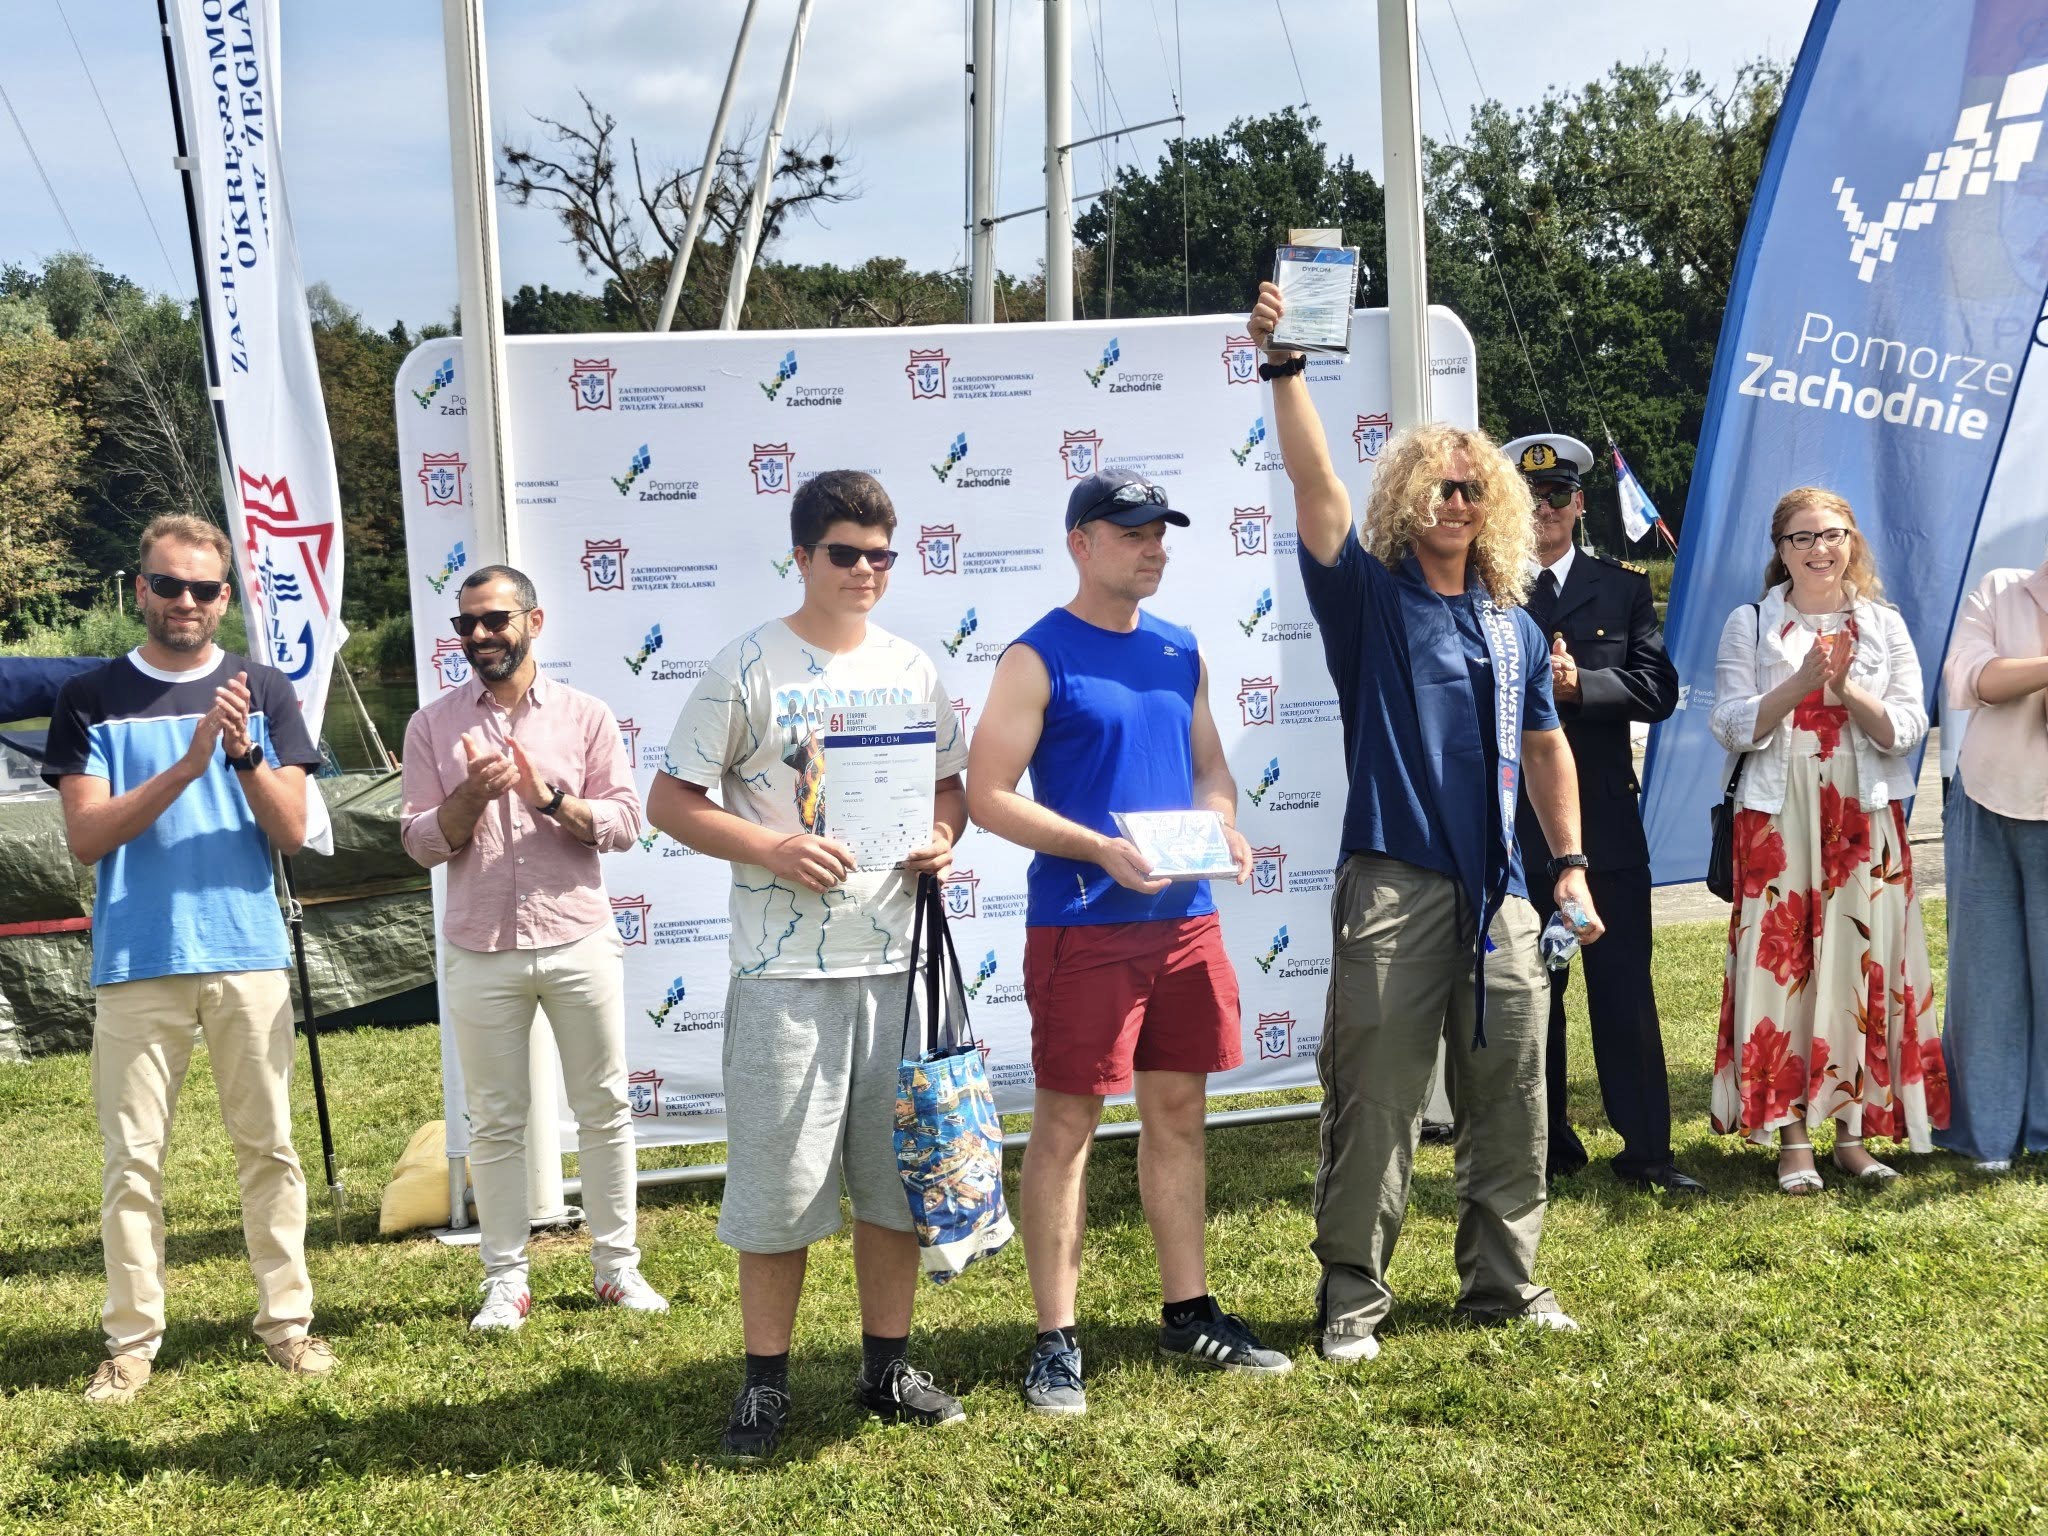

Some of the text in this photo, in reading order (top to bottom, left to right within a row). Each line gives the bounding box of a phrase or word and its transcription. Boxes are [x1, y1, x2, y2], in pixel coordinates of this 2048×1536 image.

[1797, 312, 2014, 396] Pomorze
[1431, 356, 1468, 367] omorze
[1118, 372, 1164, 383] Pomorze
[1304, 374, 1342, 383] EGLARSKI
[796, 386, 844, 397] Pomorze
[1109, 382, 1162, 393] Zachodnie
[786, 396, 842, 407] Zachodnie
[1738, 352, 1989, 440] Zachodnie
[1255, 461, 1284, 471] Zacho
[966, 467, 1012, 478] Pomorze
[650, 480, 699, 491] Pomorze
[957, 477, 1010, 488] Zachodnie
[516, 497, 557, 505] EGLARSKI
[639, 490, 697, 501] Zachodnie
[1271, 621, 1314, 632] Pomorze
[1261, 630, 1312, 642] Zachodnie
[976, 642, 1008, 652] Pomo
[966, 653, 1001, 663] Zacho
[861, 735, 900, 745] DYPLOM
[1278, 791, 1322, 801] Pomorze
[1269, 800, 1319, 811] Zachodnie
[692, 933, 729, 942] ŻEGLARS
[1287, 957, 1331, 968] Pomorze
[1279, 966, 1329, 978] Zachodnie
[995, 984, 1024, 994] Pomo
[986, 993, 1026, 1004] Zachod
[683, 1011, 724, 1022] Pomorz
[673, 1020, 724, 1032] Zachodni
